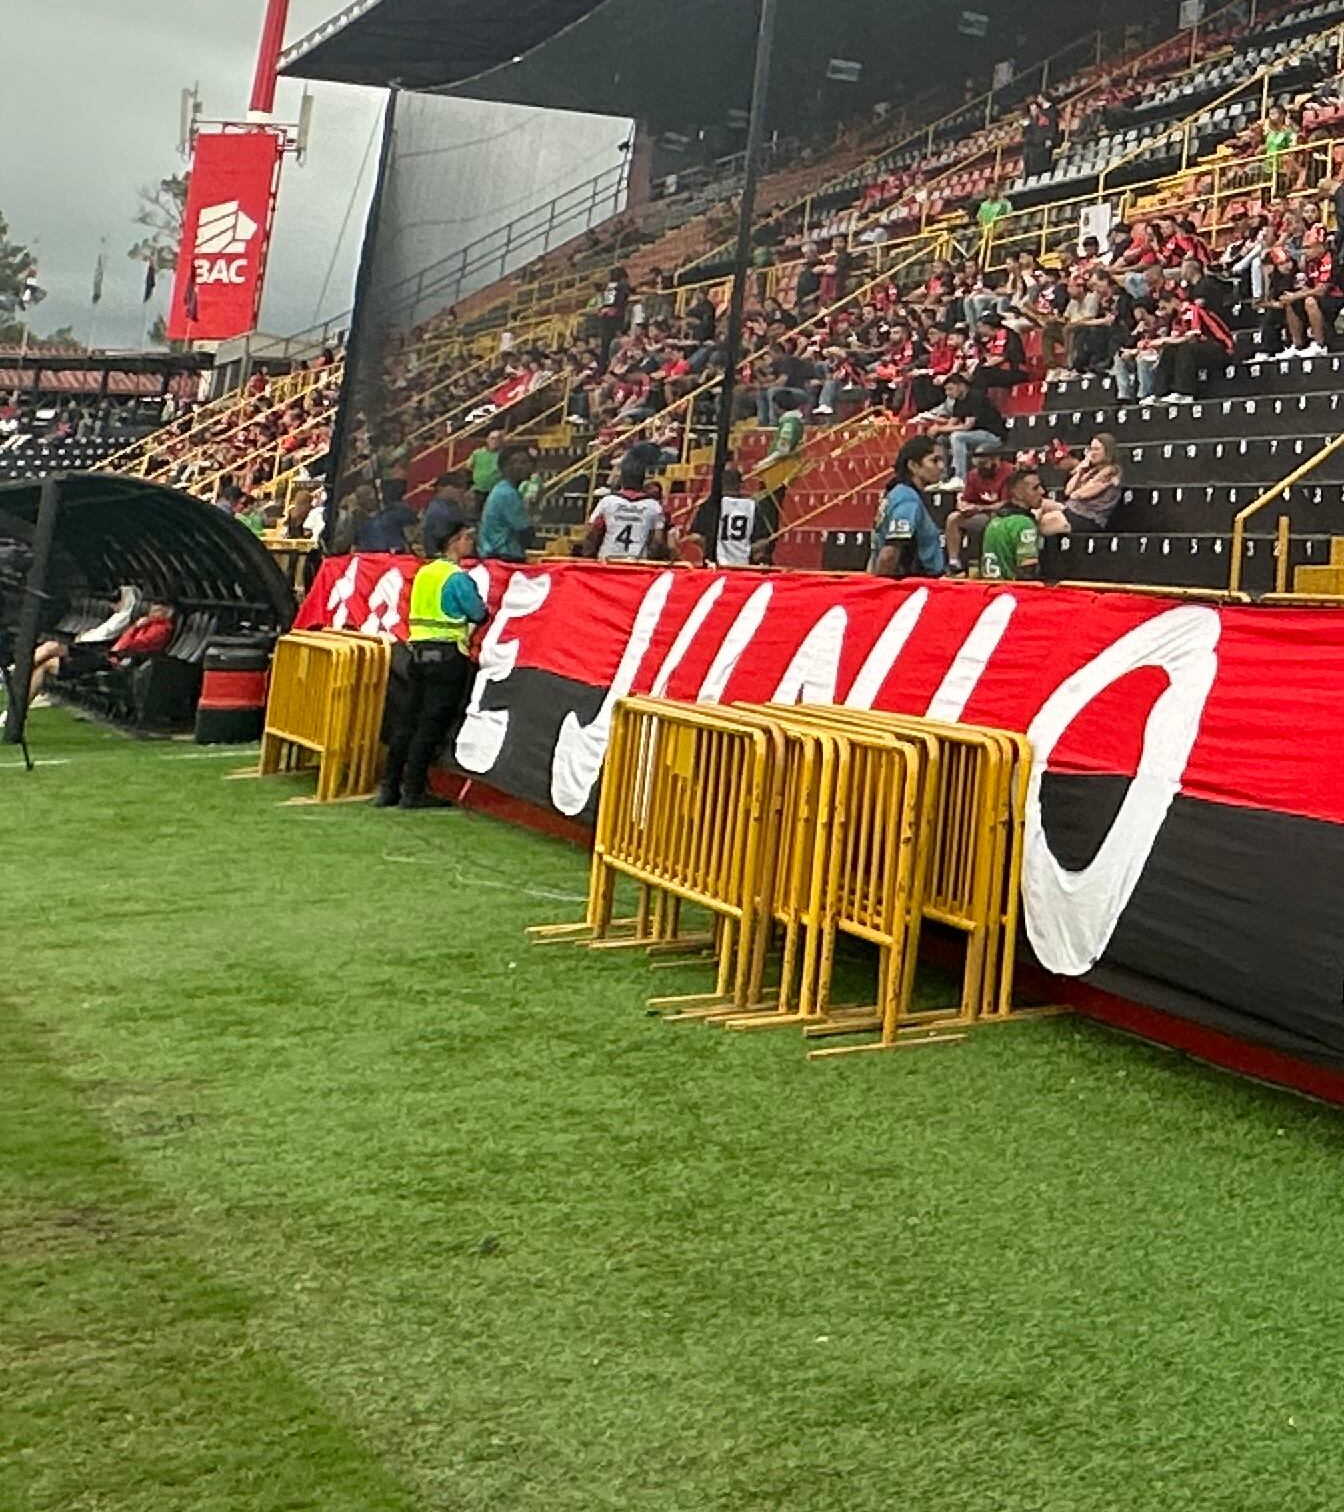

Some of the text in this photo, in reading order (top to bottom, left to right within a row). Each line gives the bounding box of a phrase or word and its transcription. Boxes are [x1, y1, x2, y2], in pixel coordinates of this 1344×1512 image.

[193, 257, 248, 285] BAC
[614, 524, 635, 552] 4
[719, 514, 749, 541] 19
